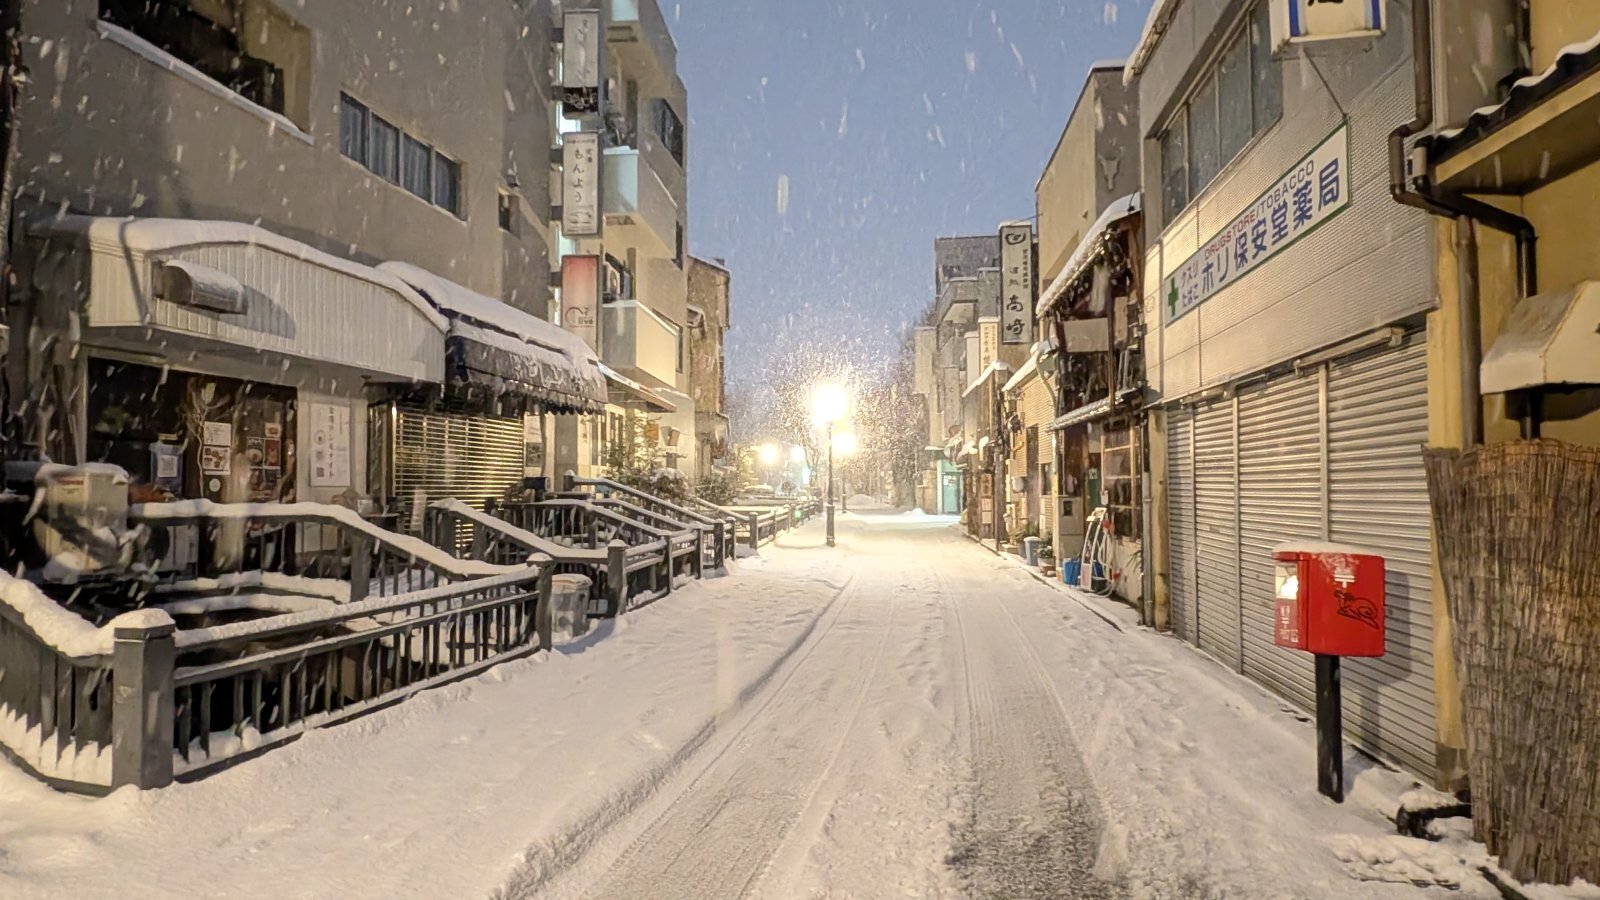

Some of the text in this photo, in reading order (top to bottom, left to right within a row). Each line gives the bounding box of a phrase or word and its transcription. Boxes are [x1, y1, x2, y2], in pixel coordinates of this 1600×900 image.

[1201, 157, 1340, 295] ホリ保安堂薬局
[1181, 259, 1199, 289] クスリ
[1181, 282, 1199, 309] たばこ
